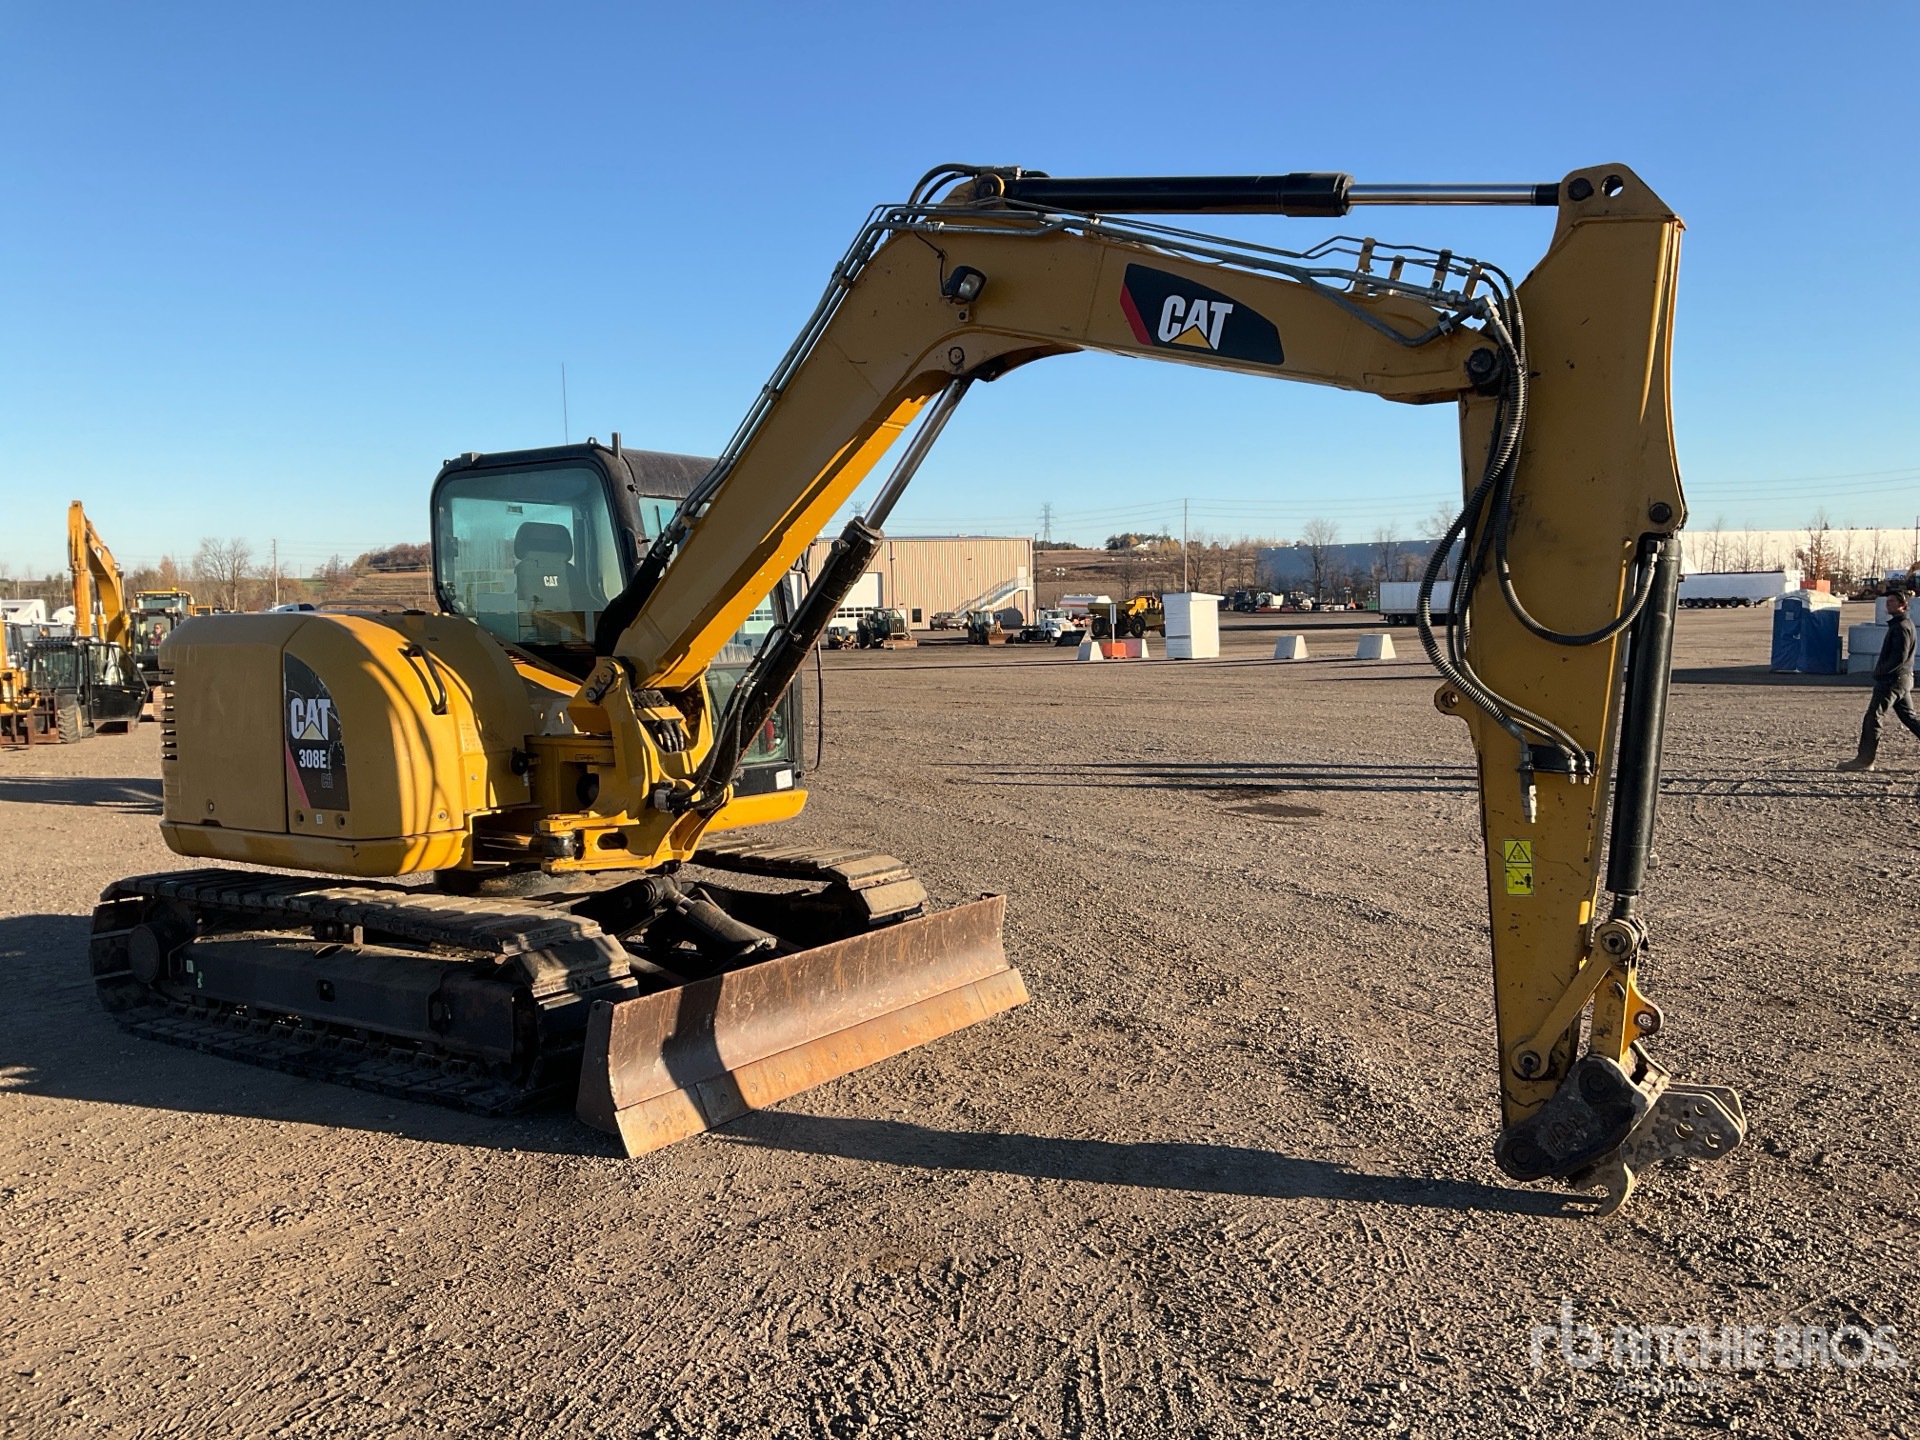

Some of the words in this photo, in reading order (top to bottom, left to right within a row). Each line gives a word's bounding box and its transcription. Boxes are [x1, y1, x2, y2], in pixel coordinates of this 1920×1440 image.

[1157, 294, 1234, 351] CAT
[543, 575, 558, 587] CAT
[290, 697, 331, 740] CAT
